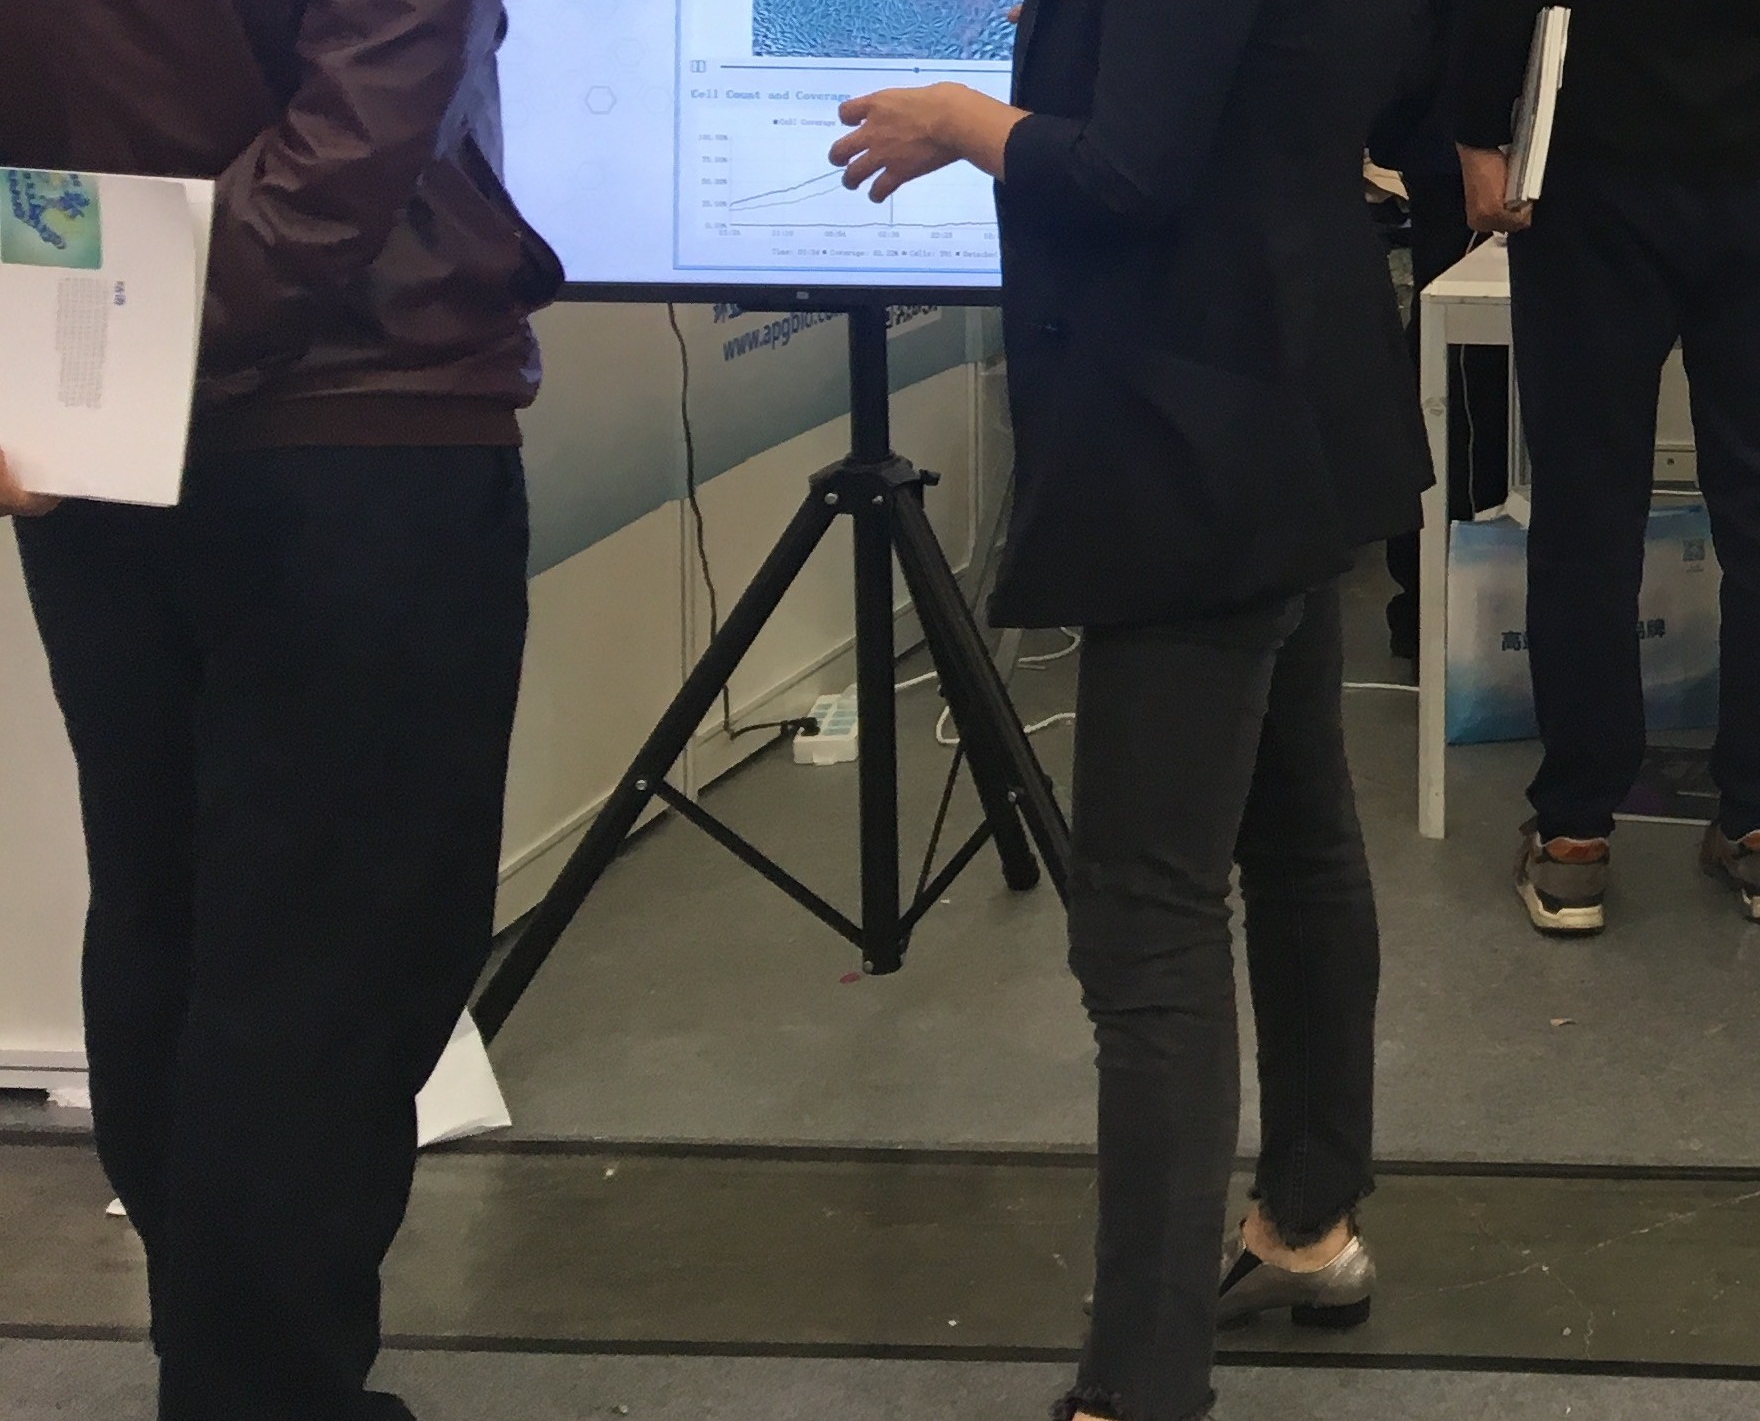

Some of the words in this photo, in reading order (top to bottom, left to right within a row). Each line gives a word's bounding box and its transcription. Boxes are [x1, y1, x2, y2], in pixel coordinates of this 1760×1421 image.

[690, 88, 719, 100] Cell
[725, 89, 761, 101] Count
[767, 90, 790, 101] and
[795, 90, 851, 103] Coverage
